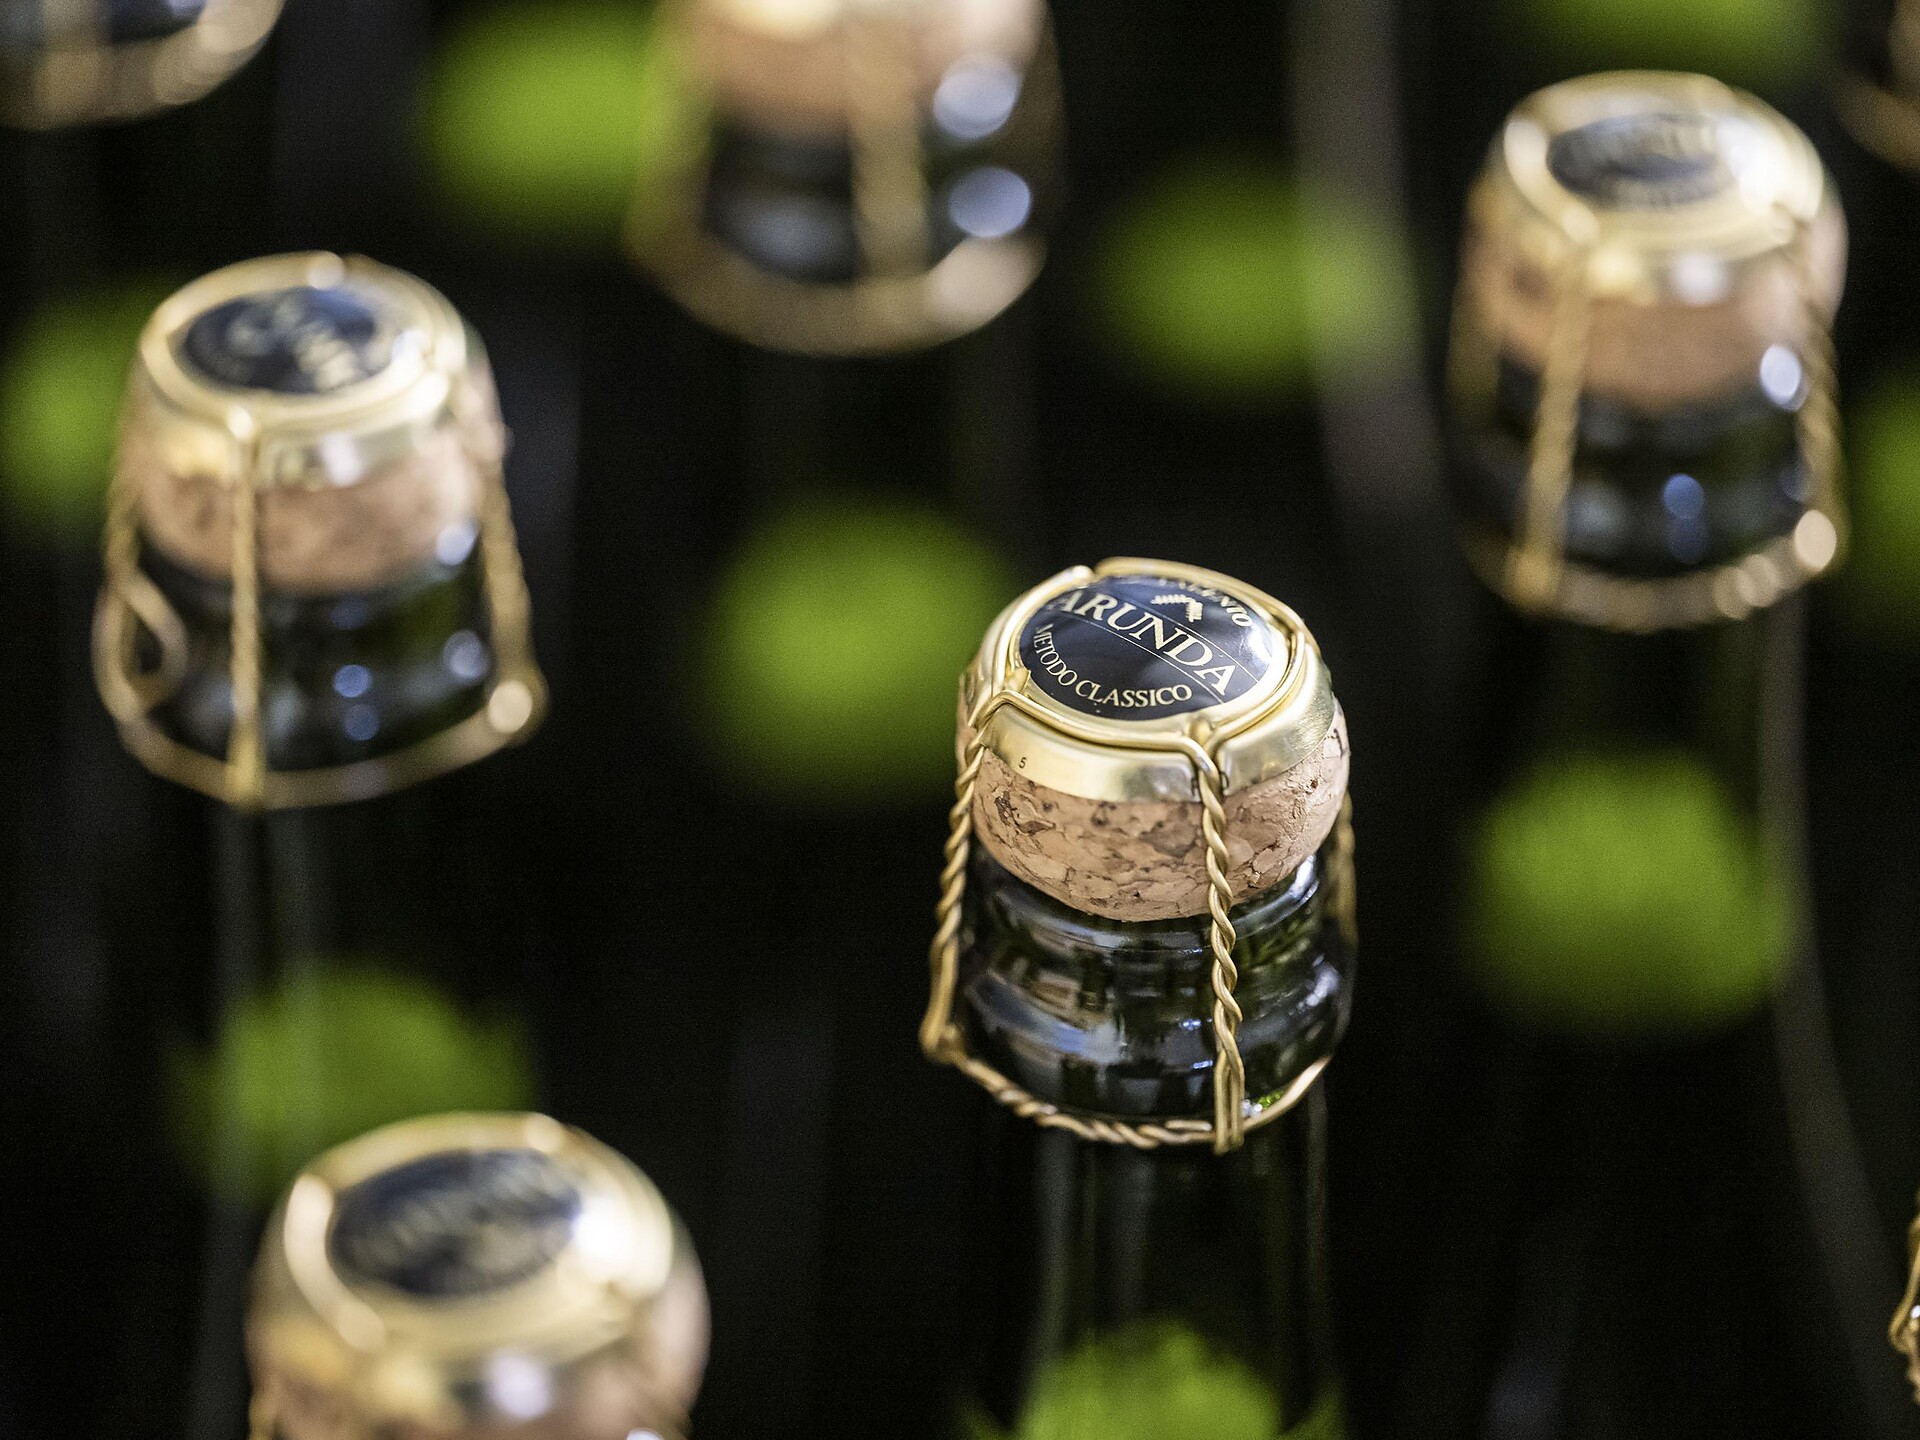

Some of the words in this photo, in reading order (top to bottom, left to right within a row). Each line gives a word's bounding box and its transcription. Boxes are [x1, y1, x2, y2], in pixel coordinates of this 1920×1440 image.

[1033, 623, 1078, 686] METODO
[1075, 679, 1193, 708] CLASSICO
[1046, 590, 1237, 696] ARUNDA
[1018, 756, 1027, 769] 5
